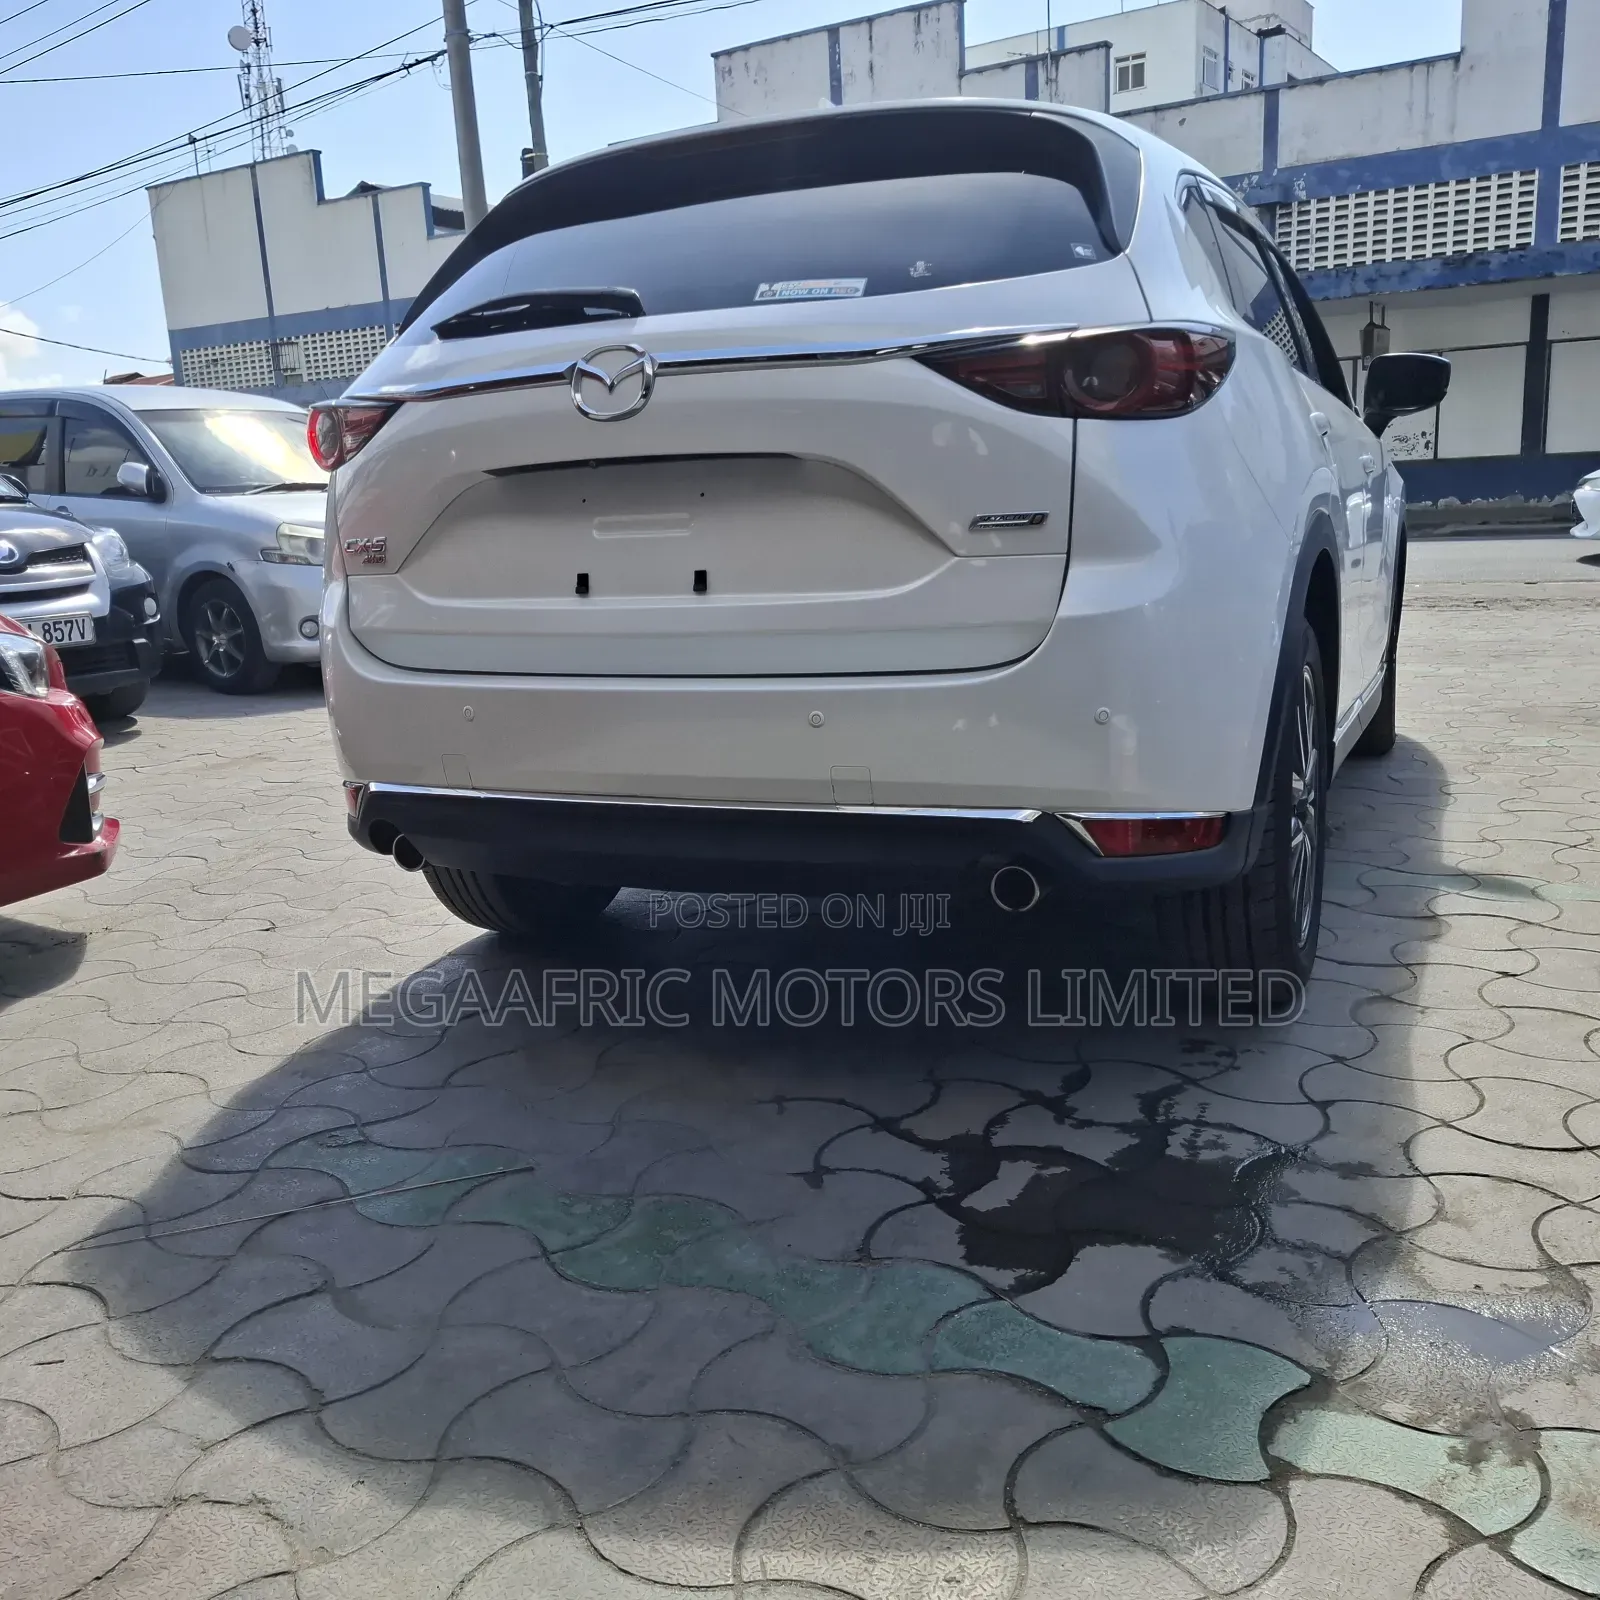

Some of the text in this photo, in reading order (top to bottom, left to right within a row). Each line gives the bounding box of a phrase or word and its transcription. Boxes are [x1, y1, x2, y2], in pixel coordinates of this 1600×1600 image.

[811, 287, 828, 295] ON
[344, 536, 387, 554] CX-5
[41, 618, 86, 644] 857V
